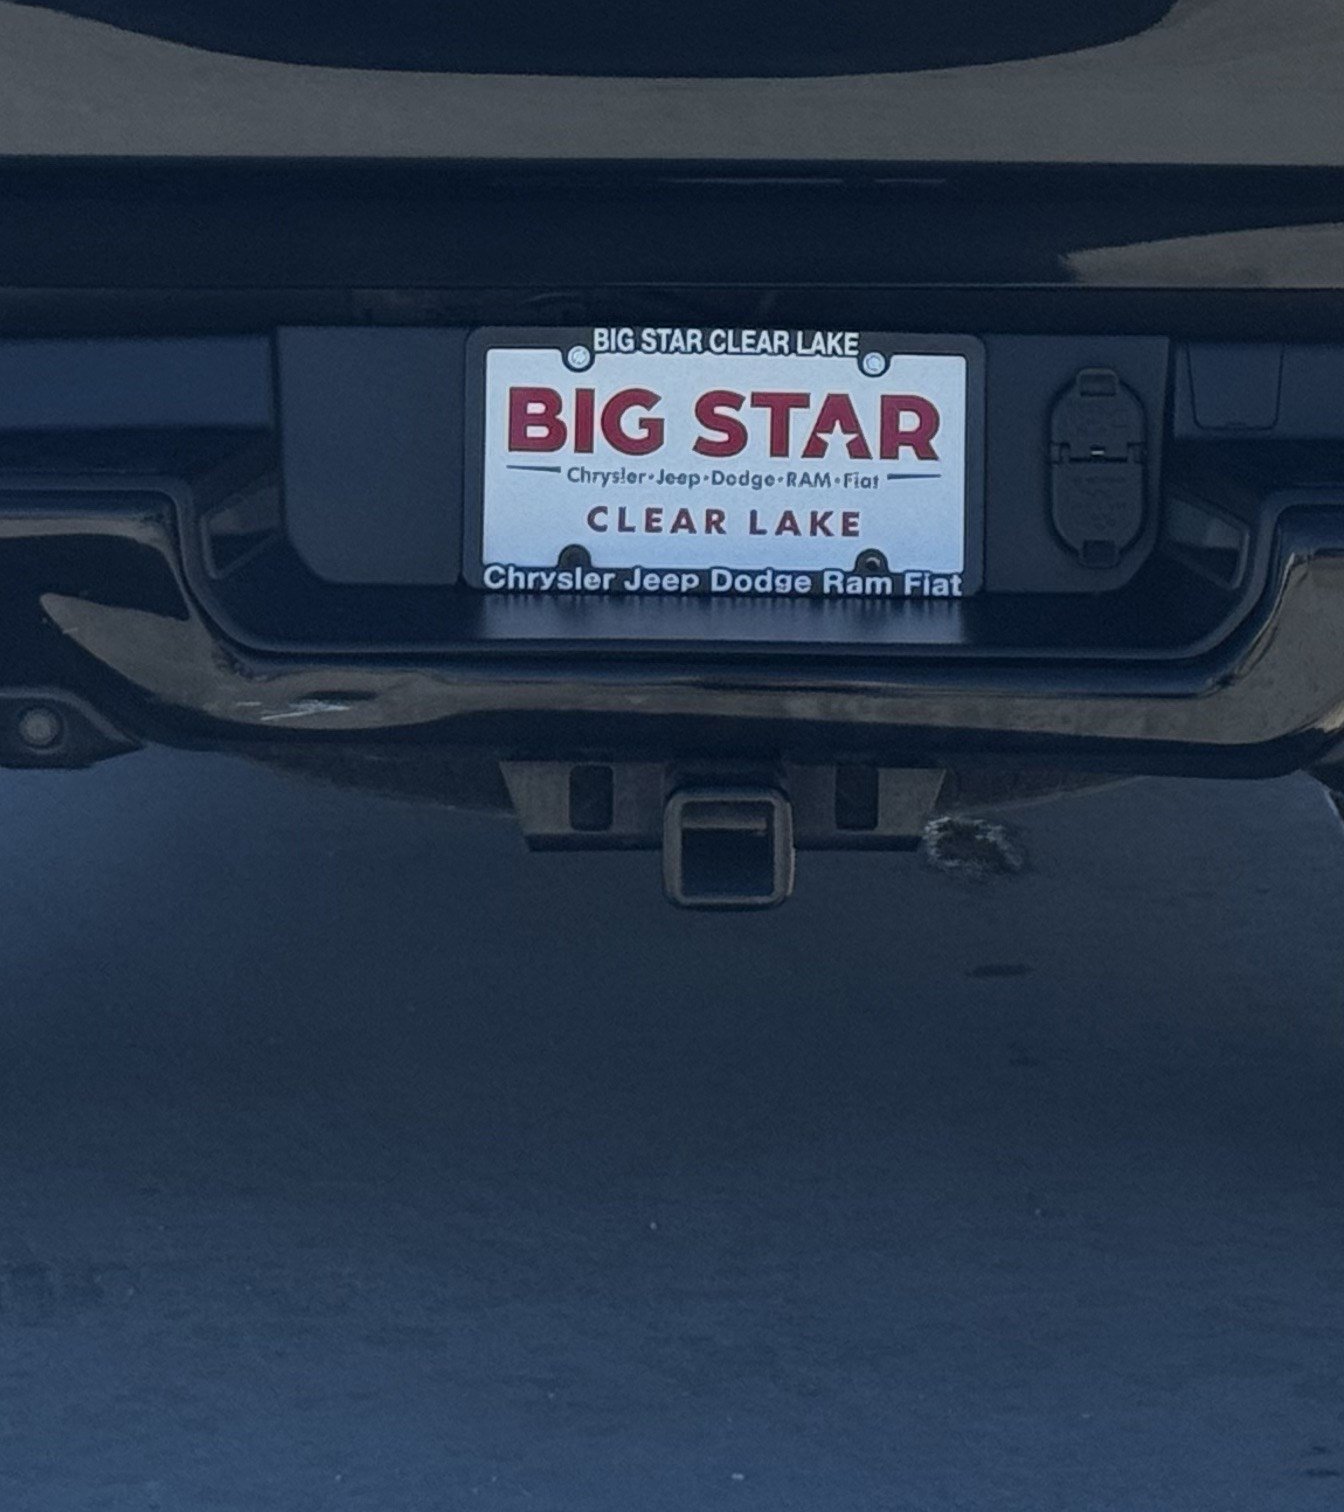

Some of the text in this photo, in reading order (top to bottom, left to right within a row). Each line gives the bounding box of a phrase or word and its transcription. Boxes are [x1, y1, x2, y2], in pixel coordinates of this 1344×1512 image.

[593, 327, 860, 356] BIG STAR CLEAR LAKE
[507, 385, 941, 461] BIG STAR
[586, 505, 861, 538] CLEAR LAKE
[483, 564, 964, 598] Chrysler Jeep Dodge Ram Fiat
